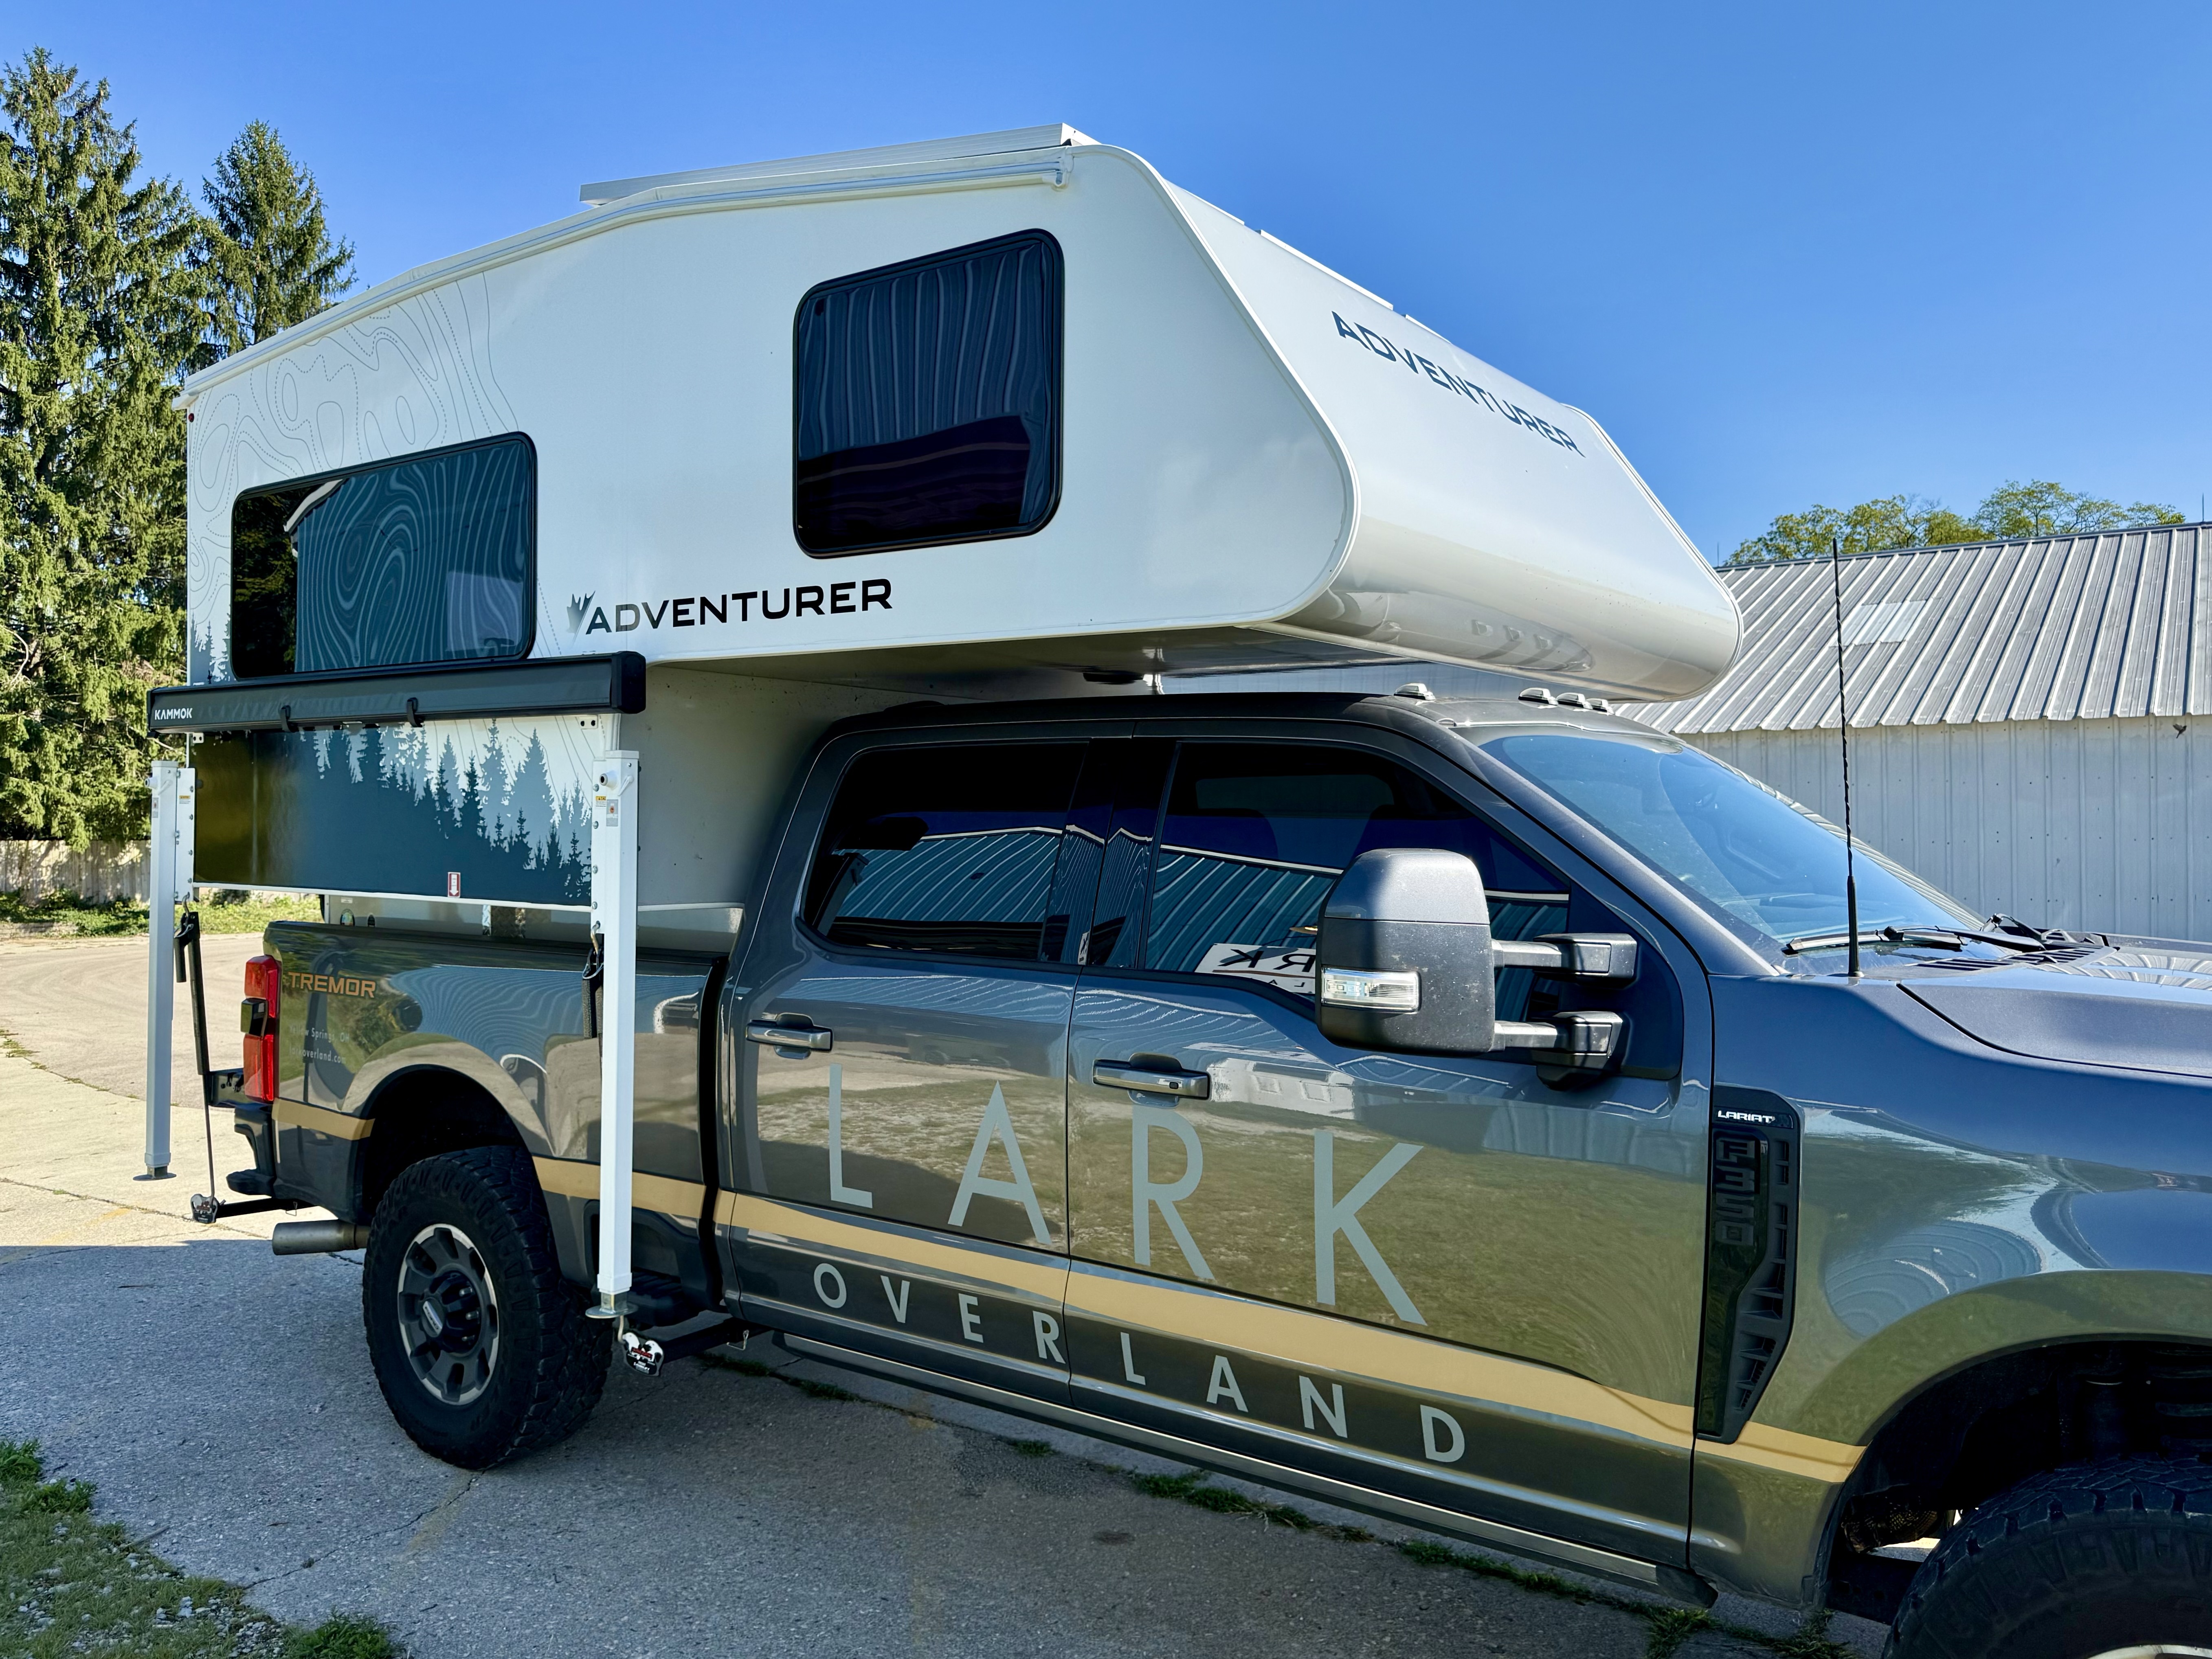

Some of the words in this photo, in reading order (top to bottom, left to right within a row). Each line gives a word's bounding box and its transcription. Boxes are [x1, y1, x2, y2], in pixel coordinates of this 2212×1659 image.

[1331, 310, 1586, 458] ADVENTURER
[585, 578, 892, 635] ADVENTURER
[154, 707, 193, 720] KAMMOK
[288, 972, 376, 998] TREMOR
[340, 1032, 350, 1043] OH
[290, 1042, 347, 1064] larkoverland.com
[1718, 1110, 1776, 1123] LARIAT
[813, 1263, 1466, 1463] OVERLAND
